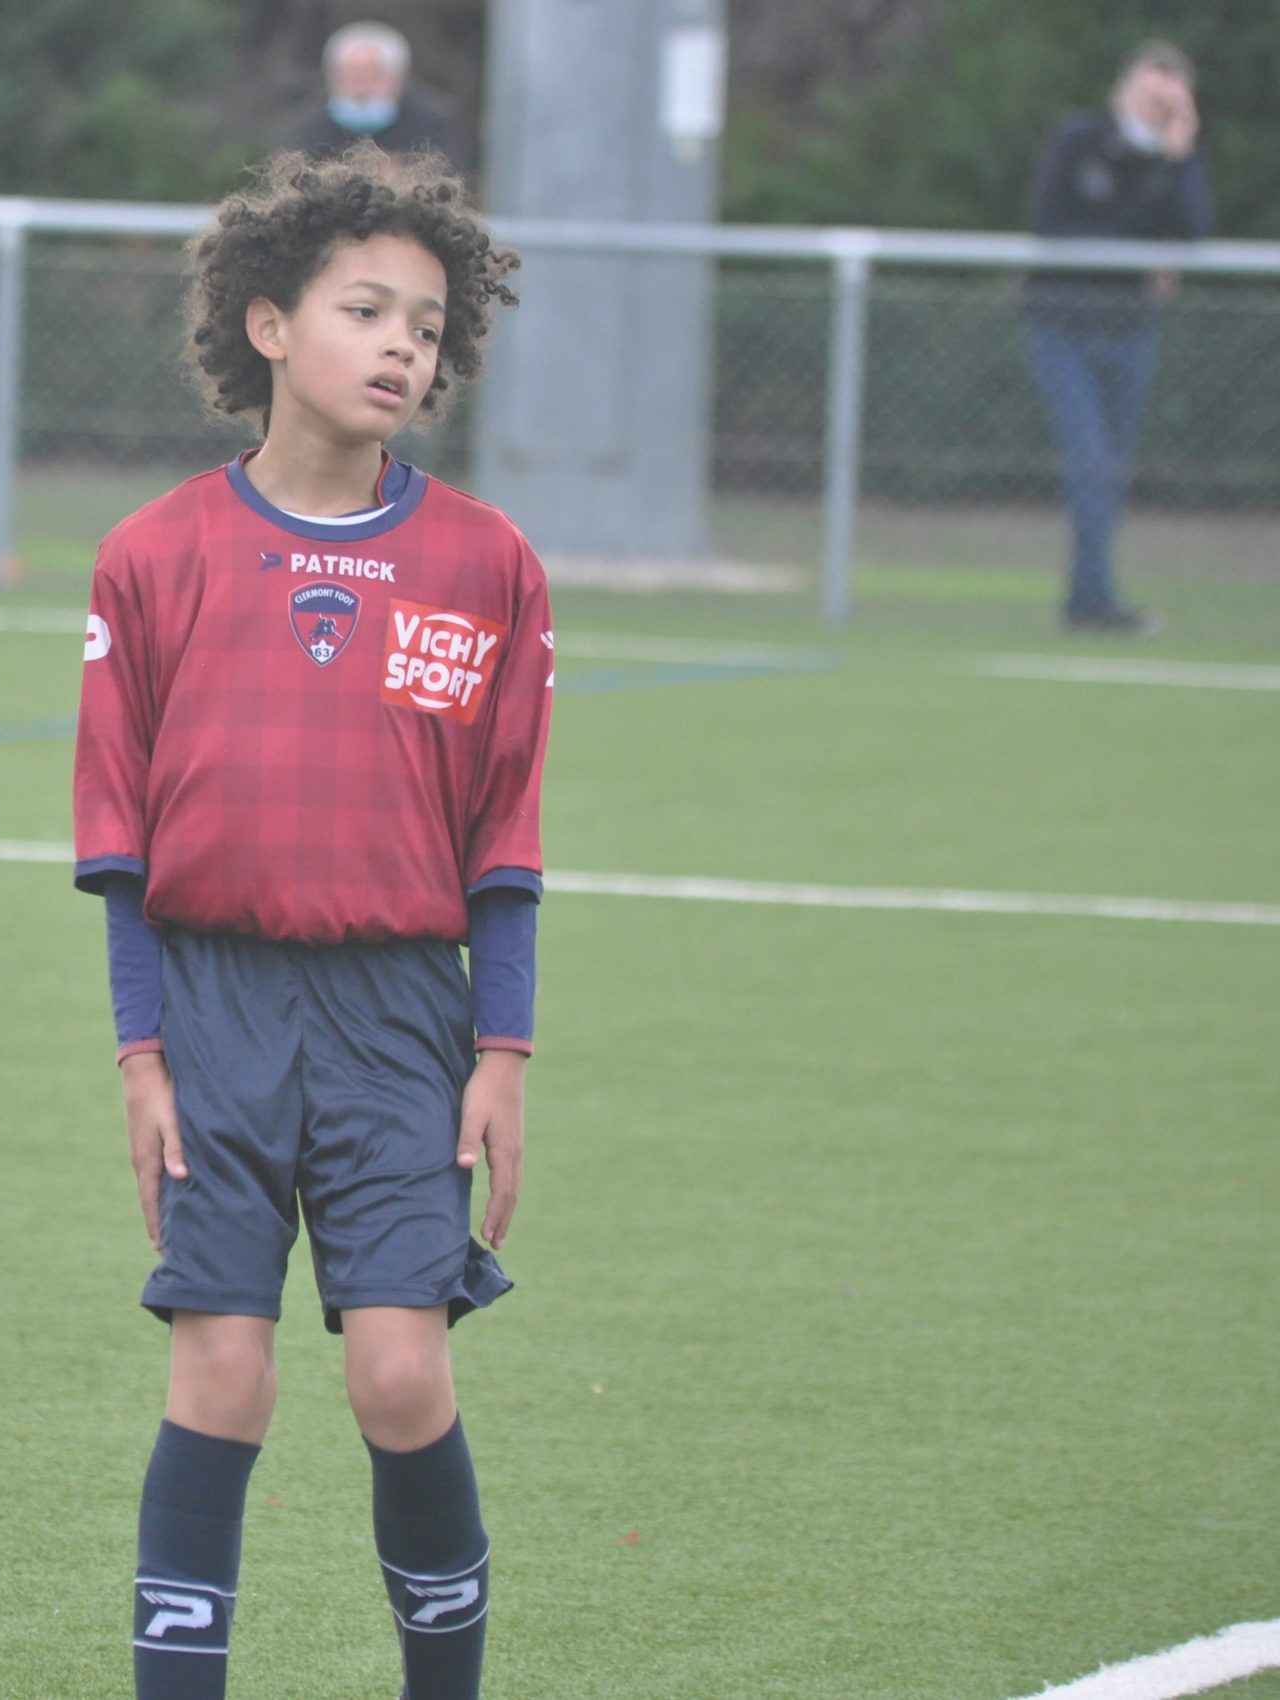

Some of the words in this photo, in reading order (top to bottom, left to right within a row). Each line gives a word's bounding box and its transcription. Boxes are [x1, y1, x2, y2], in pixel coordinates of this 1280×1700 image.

[290, 552, 396, 582] PATRICK
[294, 587, 334, 604] CLERMONT
[334, 590, 355, 606] FOOT
[314, 647, 331, 658] 63
[392, 610, 498, 668] VICHY
[384, 653, 483, 708] SPORT
